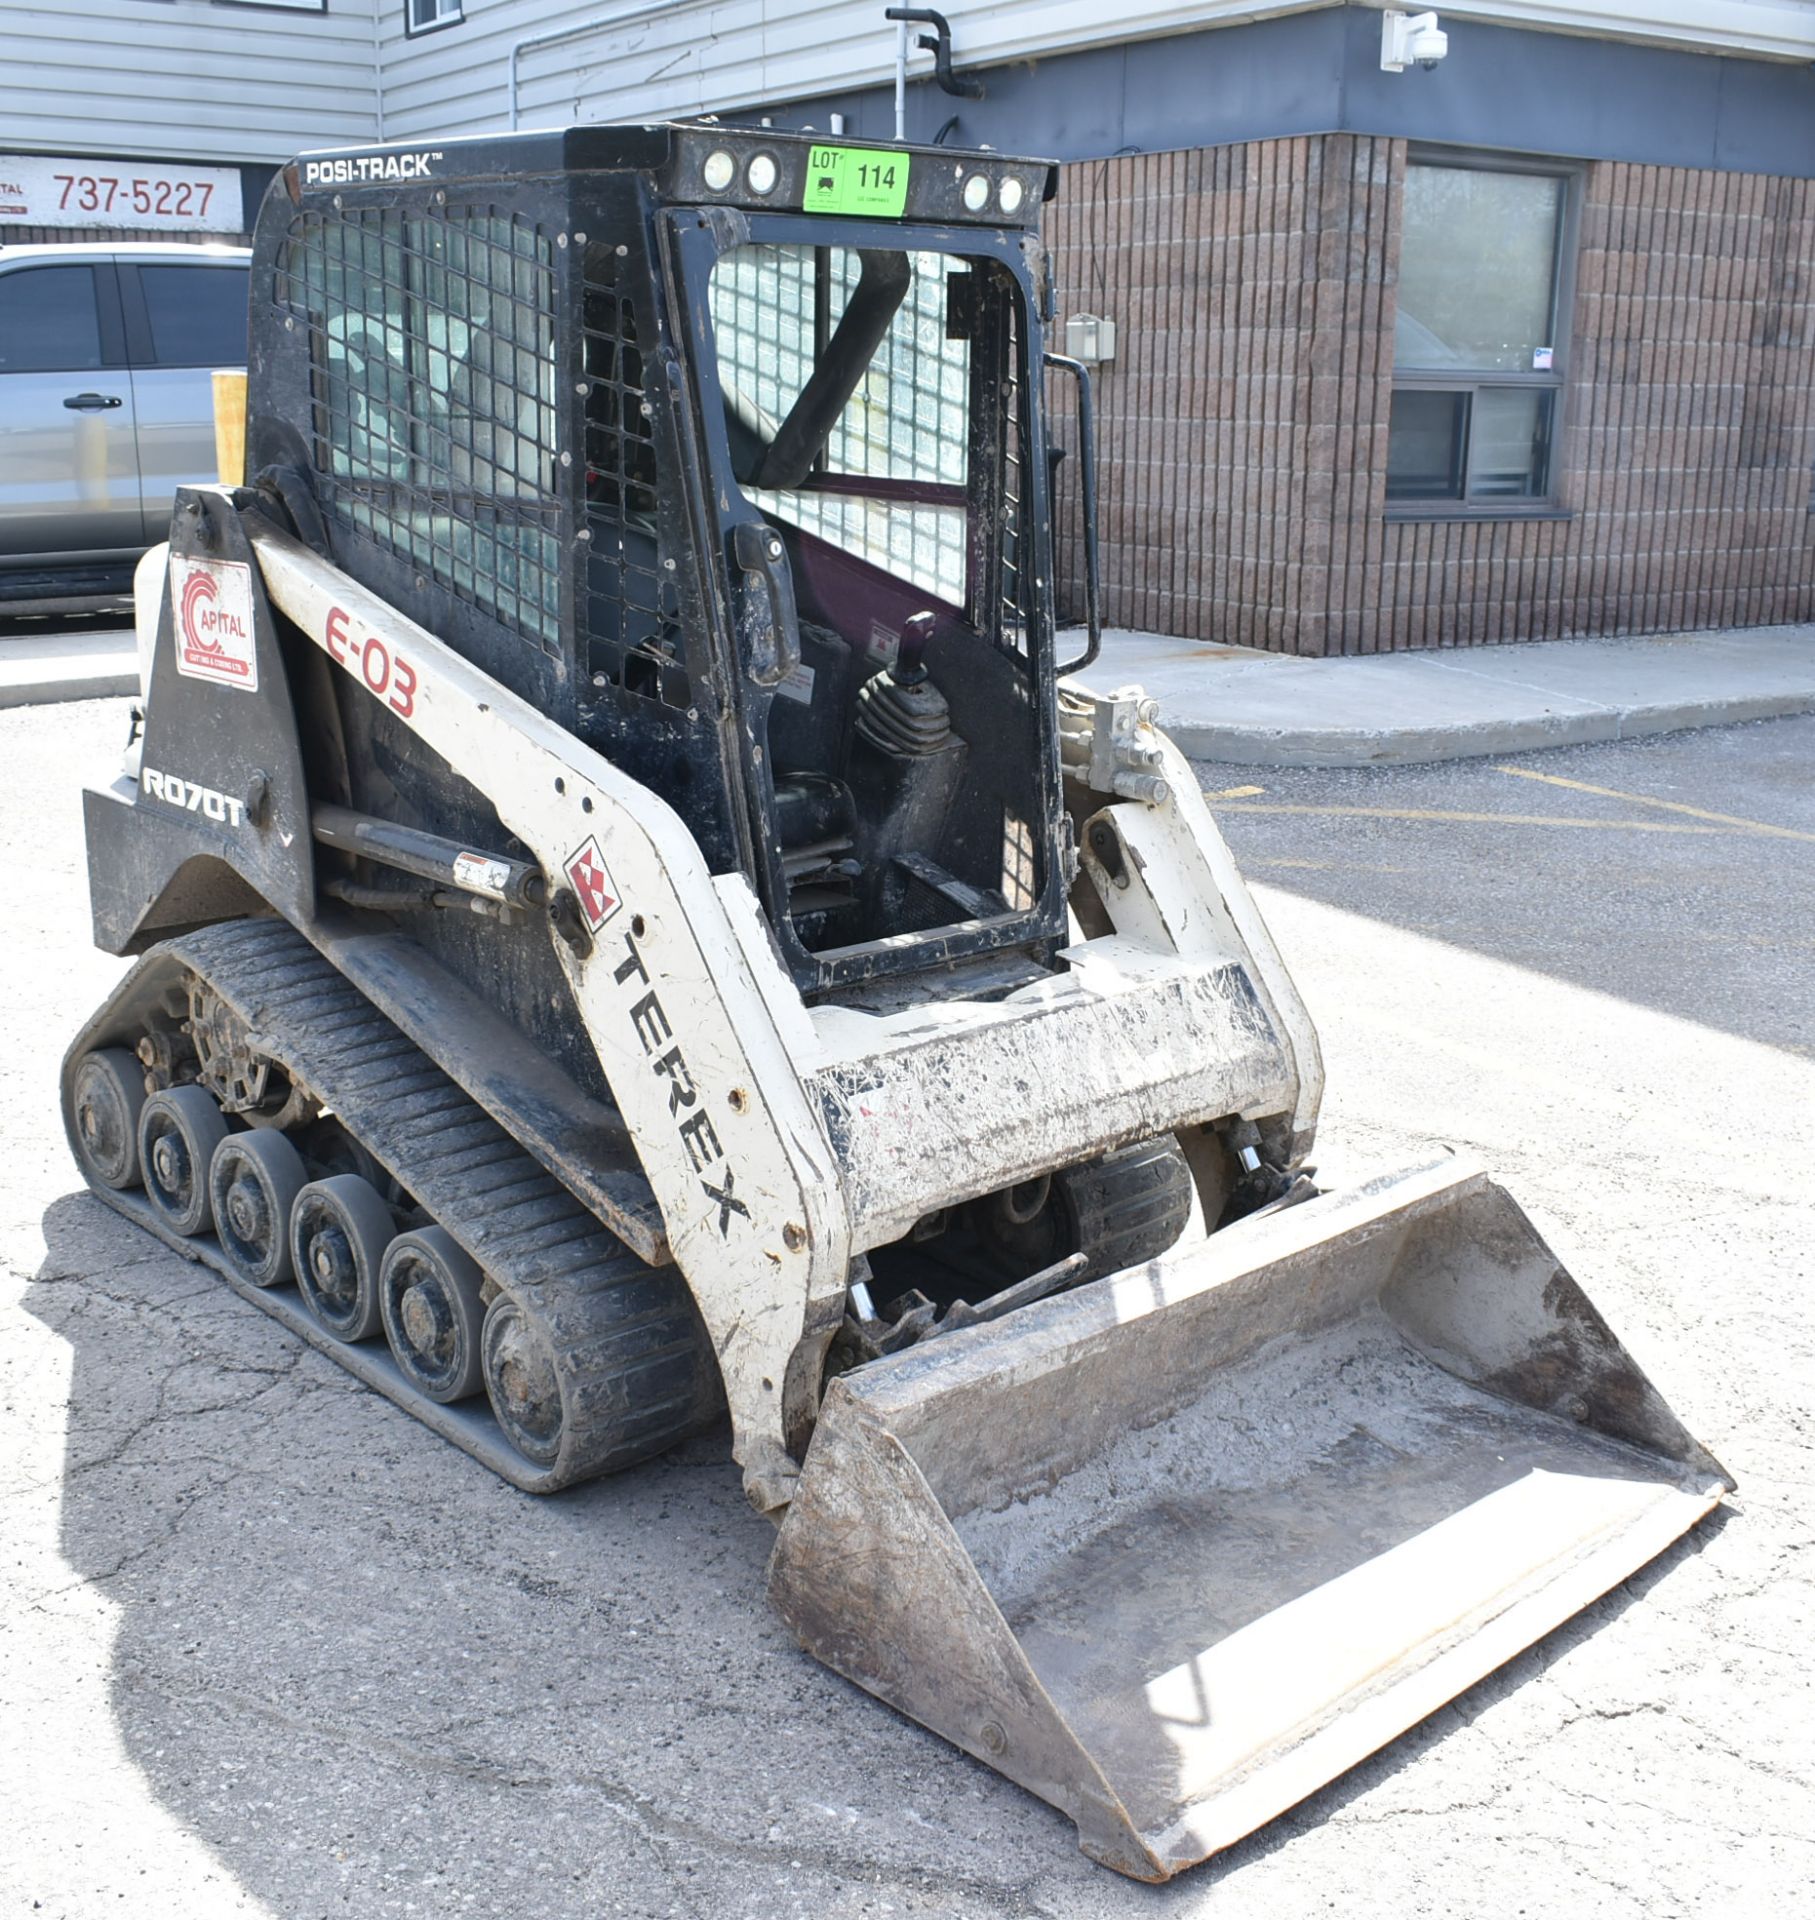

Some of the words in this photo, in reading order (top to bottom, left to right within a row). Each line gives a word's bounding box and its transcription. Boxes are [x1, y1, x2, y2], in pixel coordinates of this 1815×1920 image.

[53, 175, 214, 217] 737-5227
[858, 164, 895, 189] 114
[326, 606, 417, 718] E-03
[613, 931, 752, 1241] TEREX
